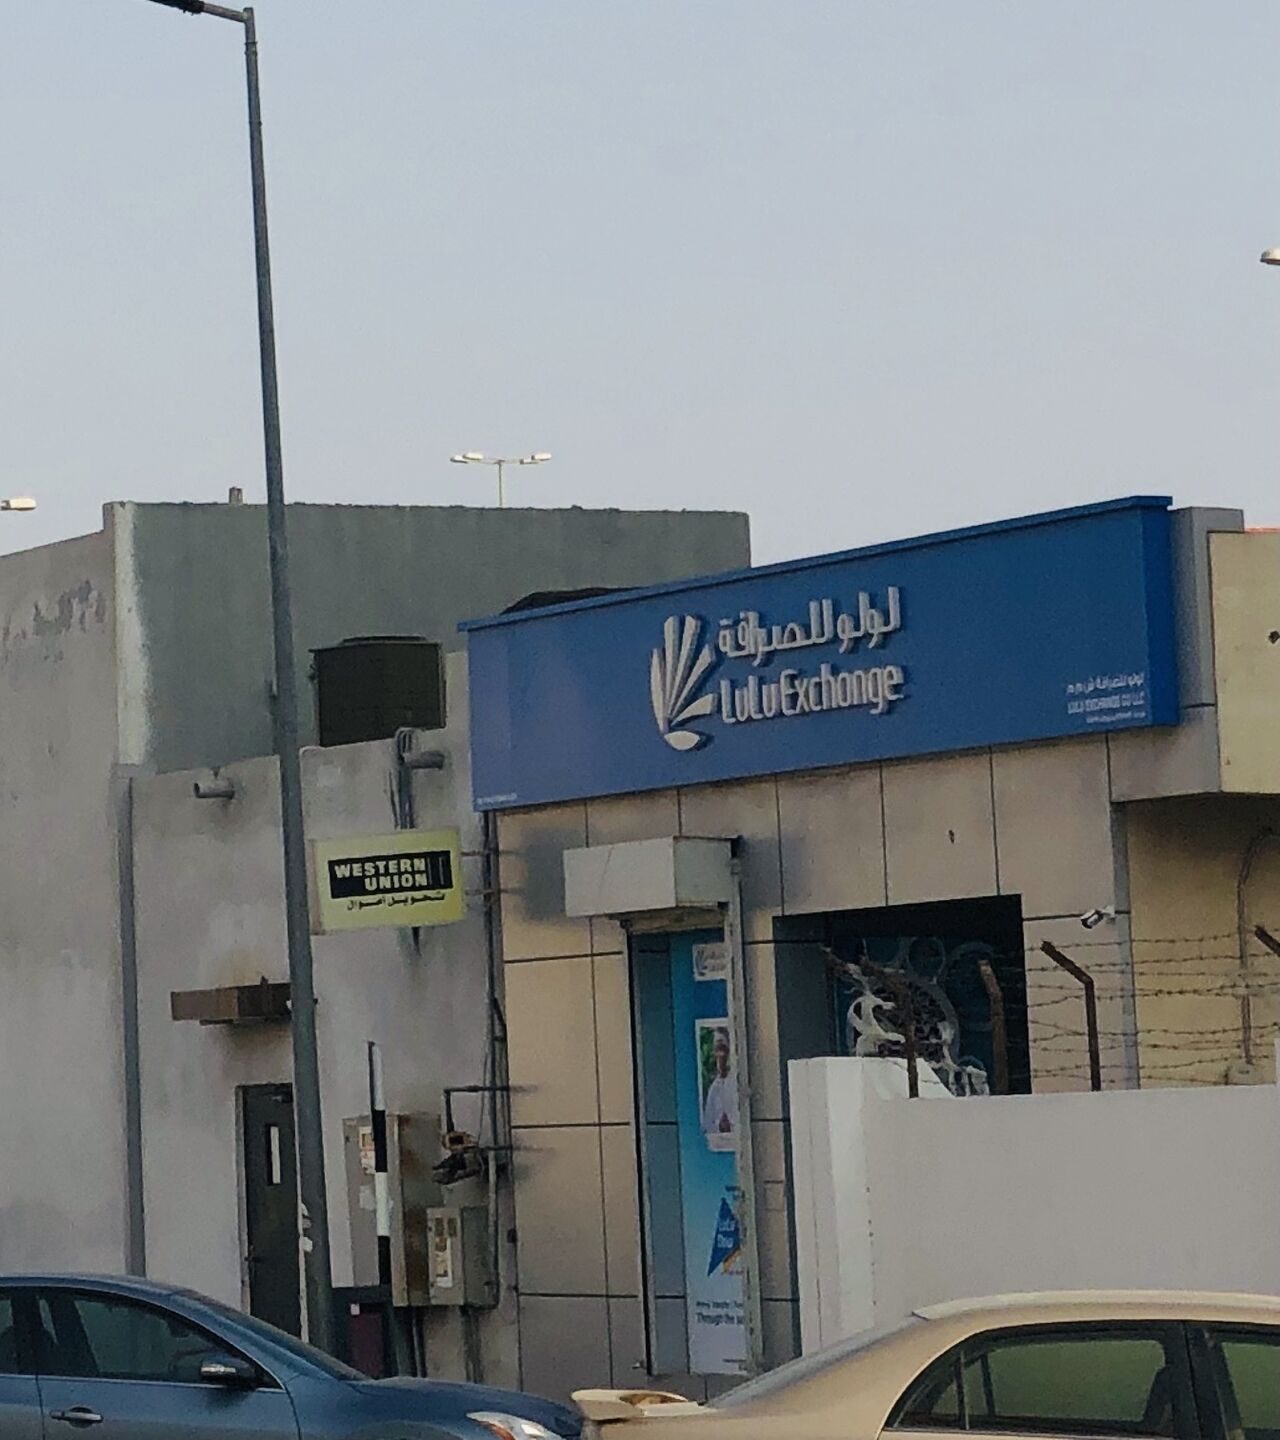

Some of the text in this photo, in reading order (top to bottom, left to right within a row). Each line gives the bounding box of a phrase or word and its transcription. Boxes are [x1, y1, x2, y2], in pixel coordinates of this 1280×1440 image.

[719, 587, 902, 666] لولو للصرافة
[334, 858, 426, 878] WESTERN
[364, 873, 428, 891] UNION
